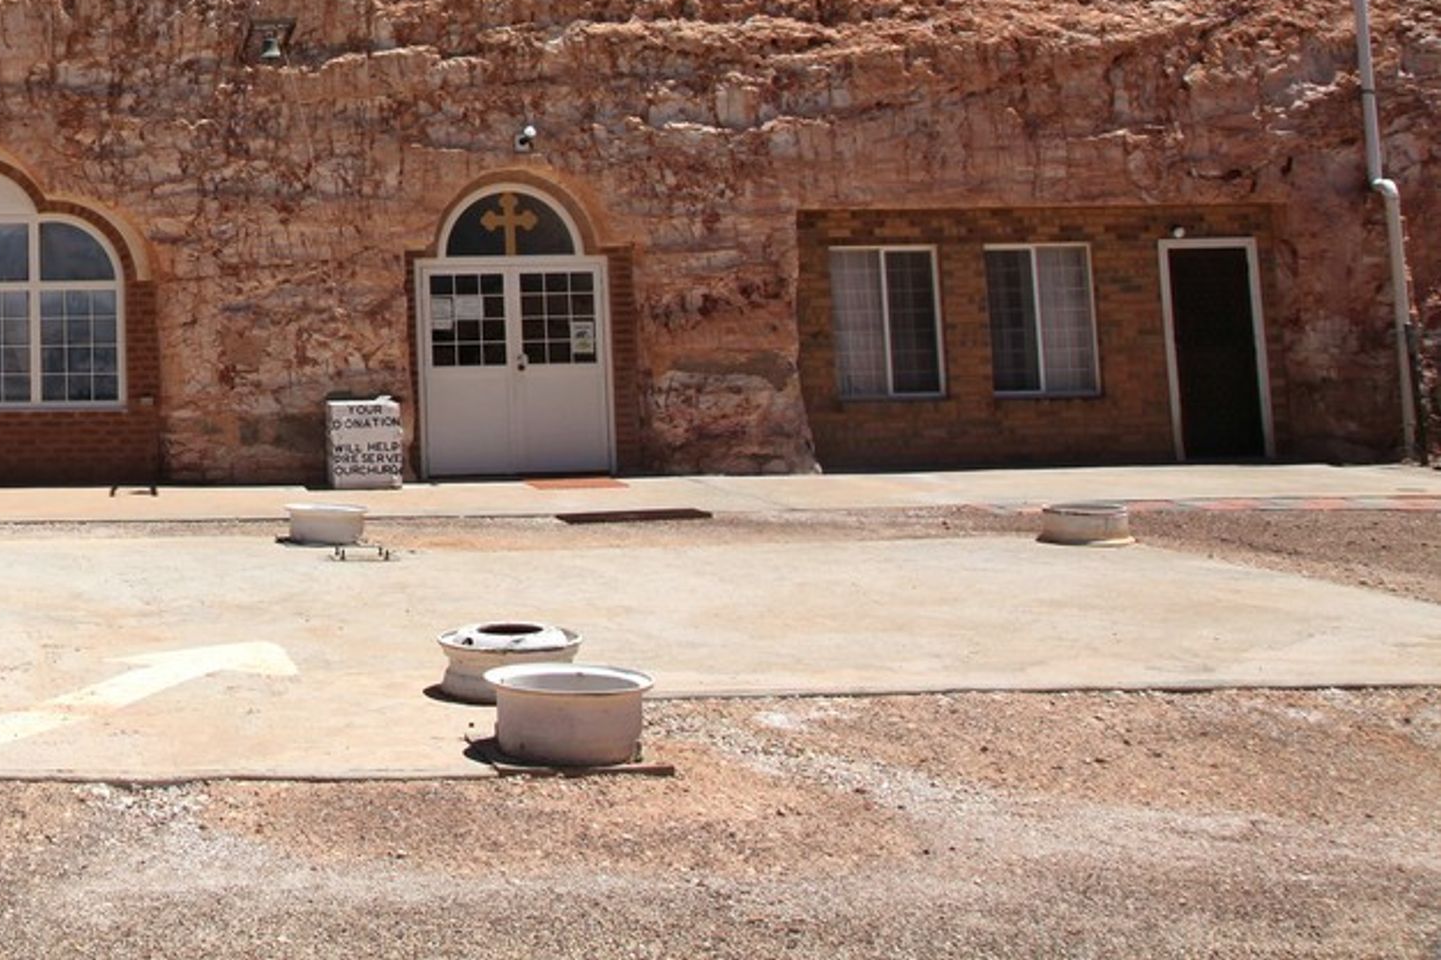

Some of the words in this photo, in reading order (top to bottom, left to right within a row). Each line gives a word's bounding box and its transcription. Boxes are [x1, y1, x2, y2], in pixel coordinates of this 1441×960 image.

[347, 405, 383, 415] YOUR
[334, 444, 362, 454] WILL
[367, 441, 401, 452] HELP
